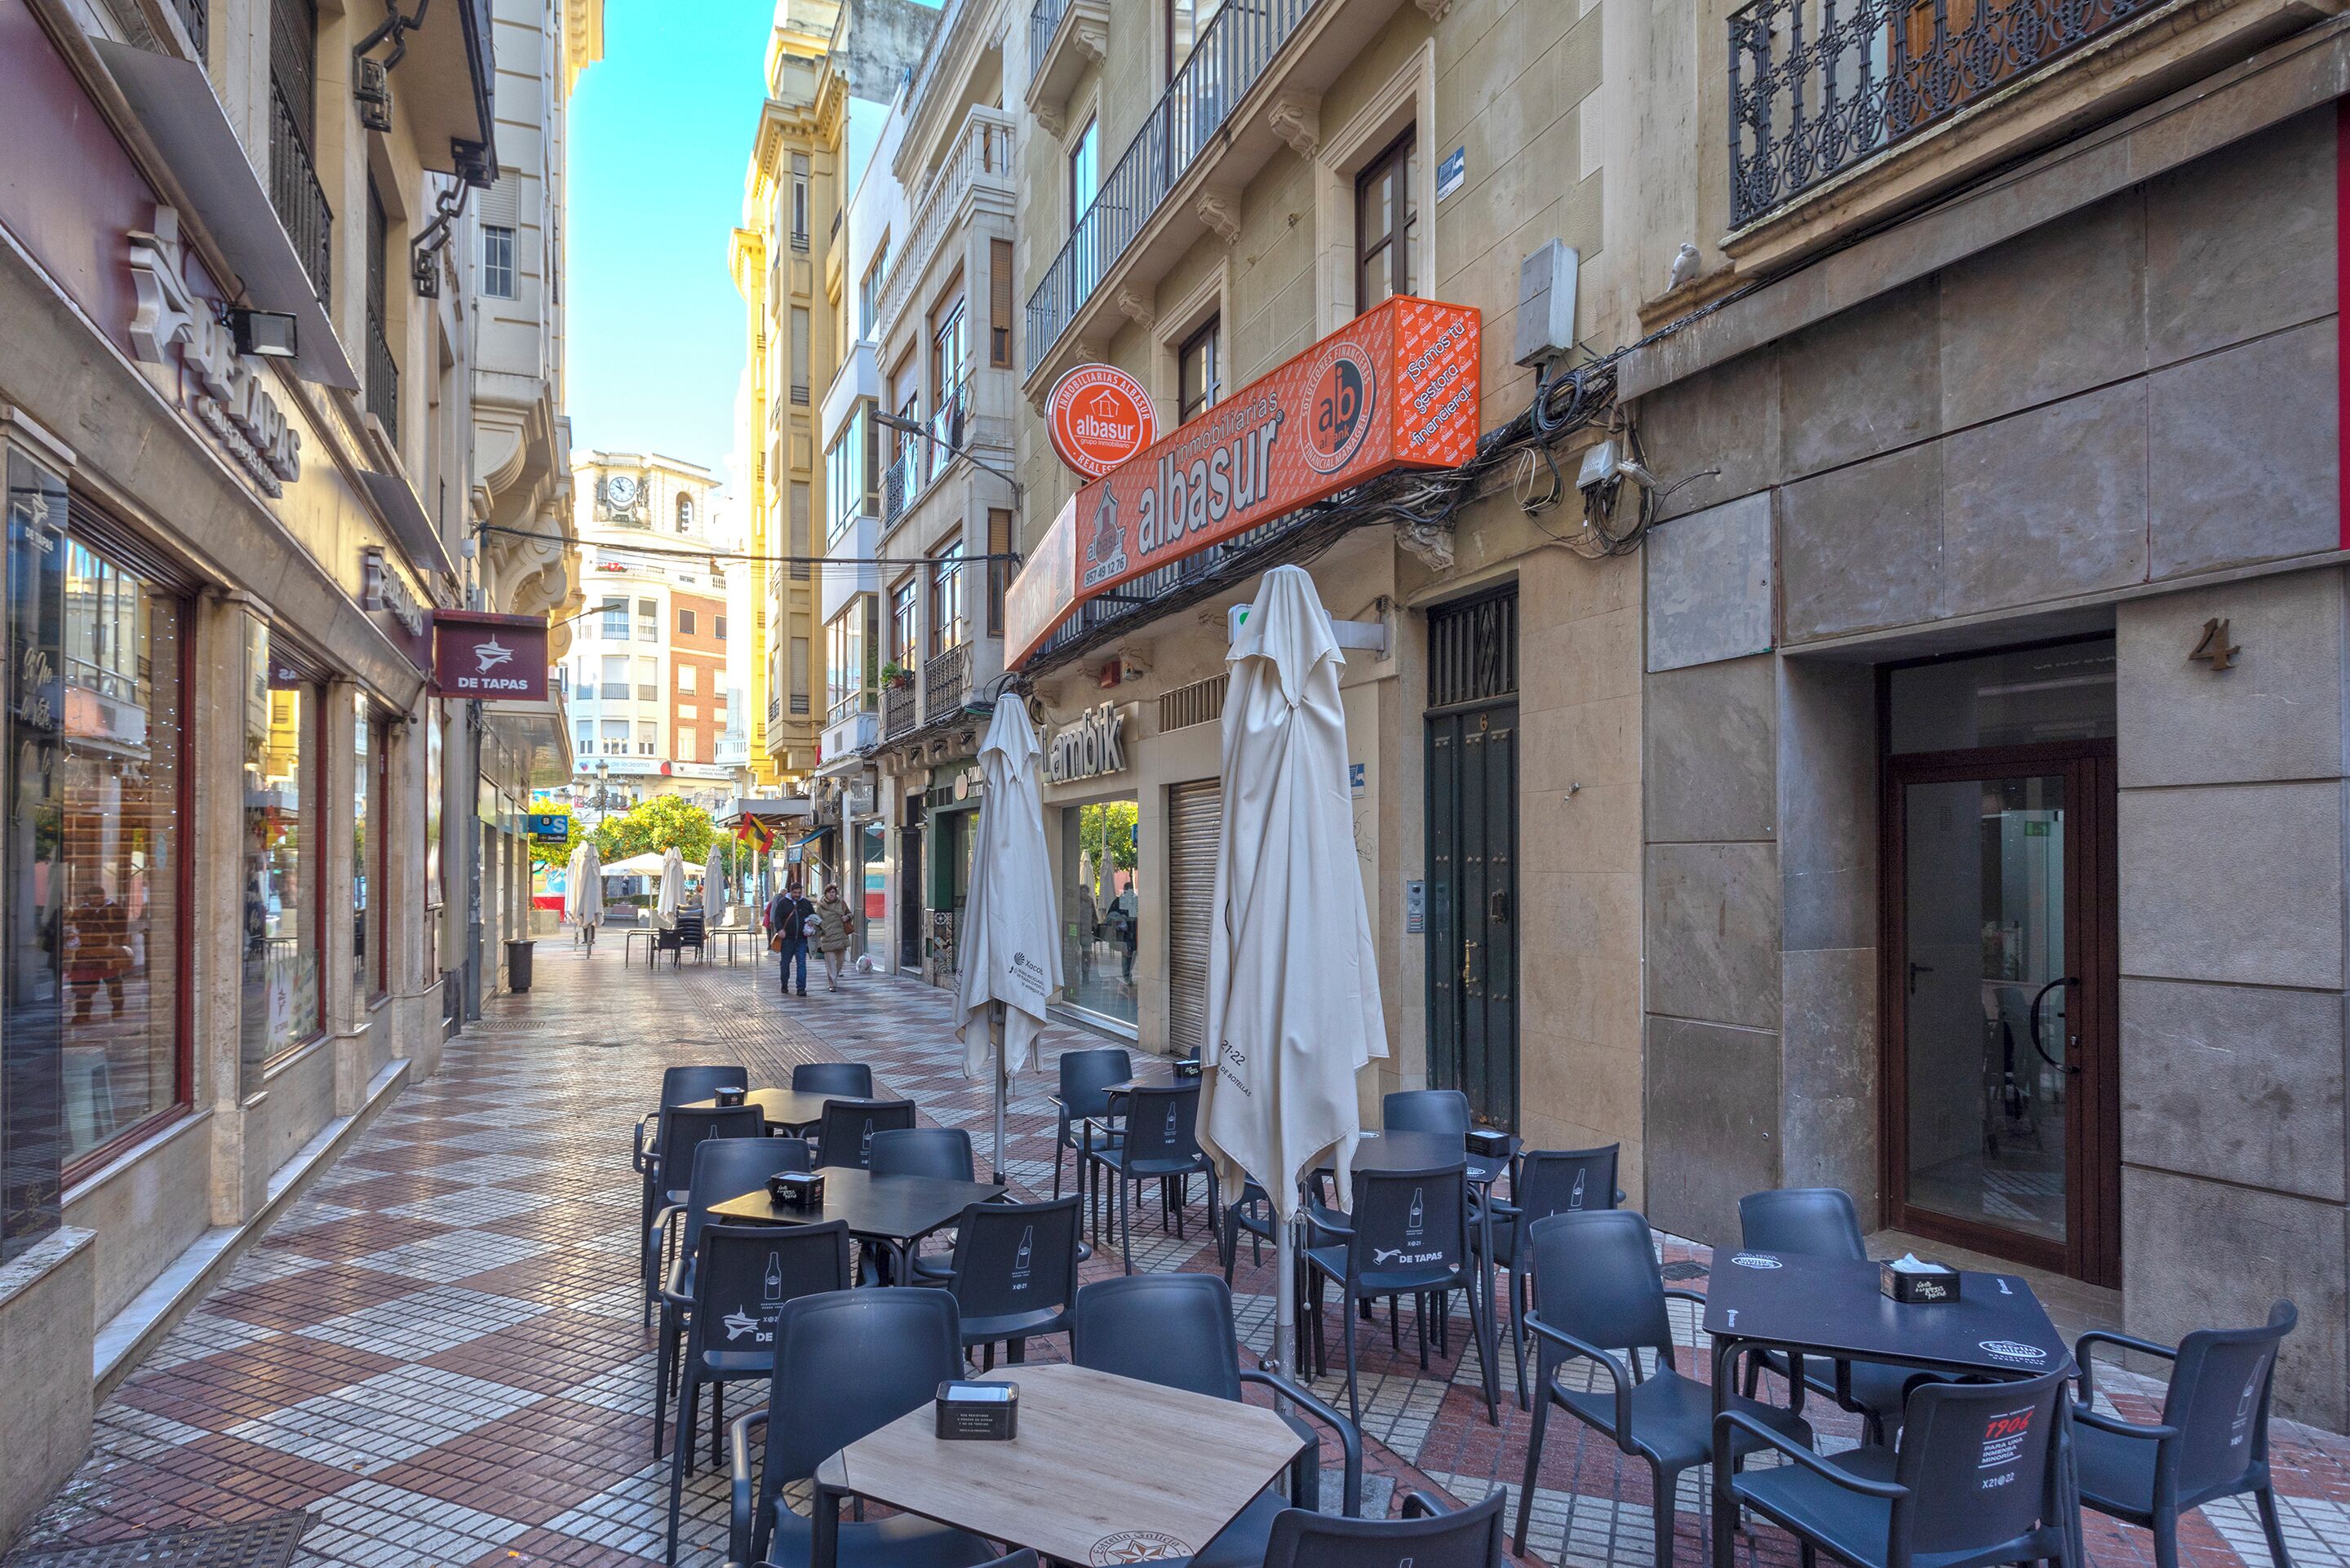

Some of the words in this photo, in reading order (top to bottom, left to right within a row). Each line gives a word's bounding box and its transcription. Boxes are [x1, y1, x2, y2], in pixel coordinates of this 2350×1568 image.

[1408, 335, 1452, 383] ¡Somos
[1448, 320, 1465, 340] tu
[184, 297, 236, 401] DE
[228, 354, 301, 482] TAPAS
[1058, 372, 1118, 410] INMOBILIARIAS
[1120, 380, 1150, 420] ALBASUR
[1301, 352, 1332, 418] SOLUCIONES
[1334, 346, 1372, 386] FINANCIERAS
[1413, 363, 1460, 414] gestora
[1177, 392, 1278, 465] inmobiliarias
[1412, 384, 1471, 447] financiera!
[1098, 441, 1130, 450] inmobiliario
[1305, 441, 1335, 469] FINANCIAL
[1334, 414, 1368, 467] MANAGER
[1077, 454, 1099, 472] REAL
[34, 532, 54, 551] TAPAS
[1085, 569, 1097, 586] 957
[1097, 565, 1105, 578] 49
[1107, 560, 1115, 574] 12
[1116, 557, 1124, 570] 76
[397, 580, 423, 636] TAPAS
[2188, 617, 2241, 671] 4
[458, 677, 478, 689] DE
[481, 678, 528, 690] TAPAS
[1479, 714, 1488, 732] 6
[1039, 700, 1127, 785] Lambik
[552, 818, 566, 834] S
[1220, 1066, 1229, 1075] DE
[1227, 1073, 1252, 1097] BOTELLAS
[1399, 1255, 1413, 1264] DE
[1414, 1251, 1443, 1263] TAPAS
[756, 1332, 773, 1342] DE
[1984, 1411, 2033, 1438] 1906
[1981, 1451, 2015, 1464] MINORÍA
[1982, 1445, 2017, 1458] INMENSA
[1984, 1442, 2006, 1451] PARA
[2007, 1437, 2024, 1446] UNA
[1093, 1533, 1131, 1555] Estrella
[1133, 1530, 1180, 1548] Galicia
